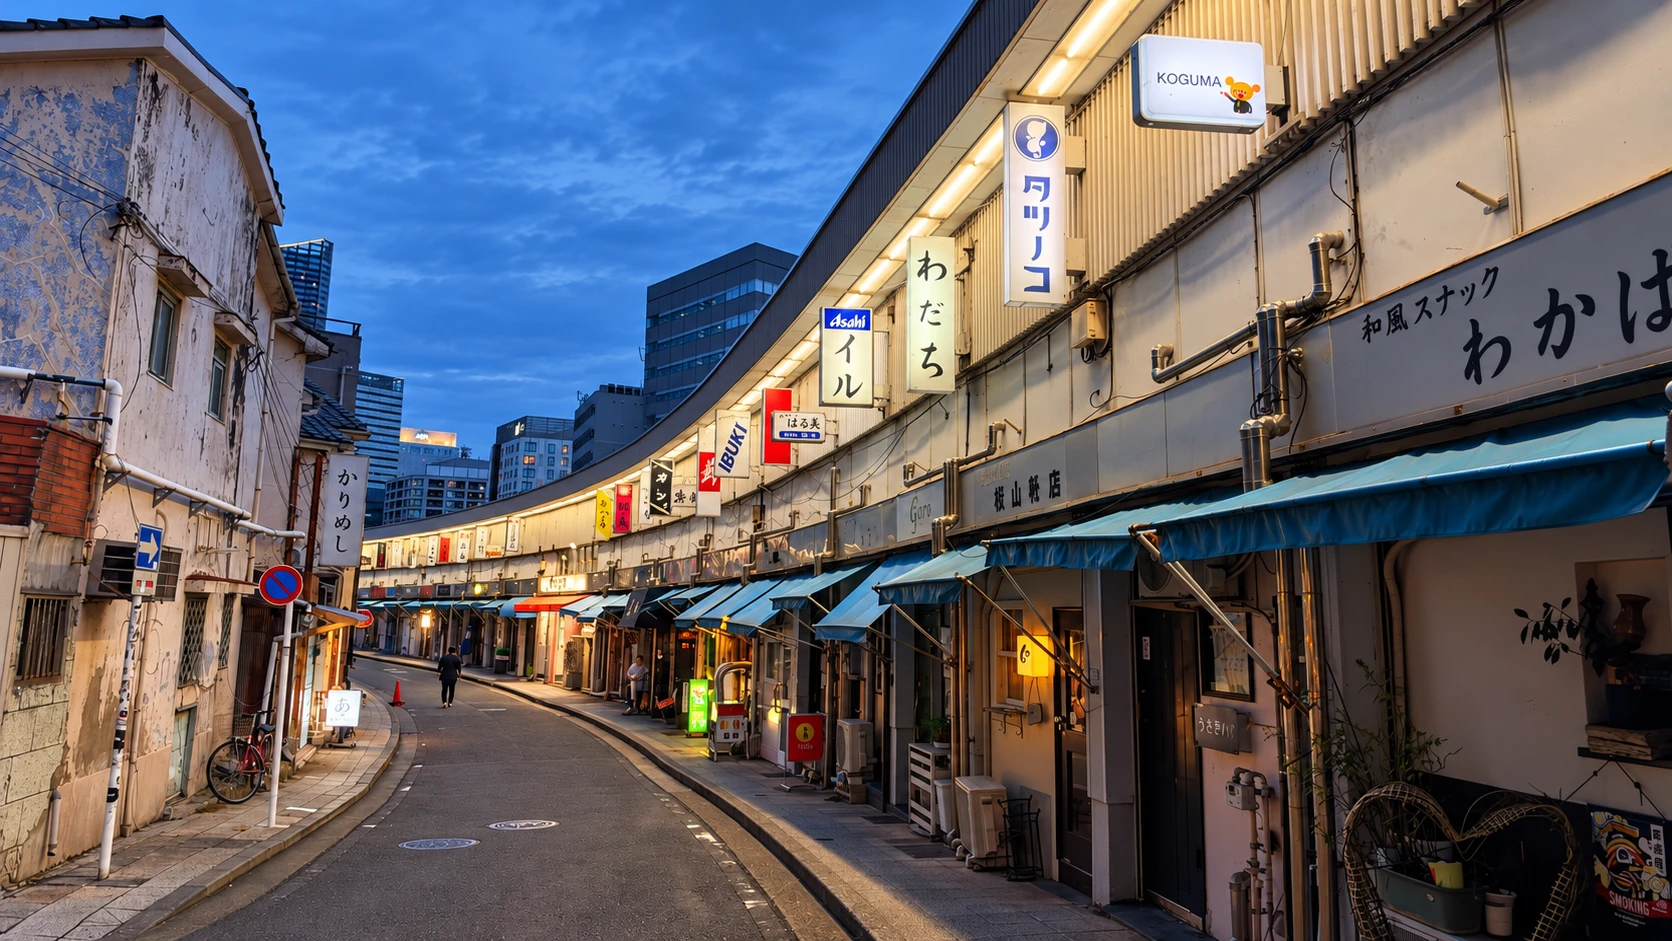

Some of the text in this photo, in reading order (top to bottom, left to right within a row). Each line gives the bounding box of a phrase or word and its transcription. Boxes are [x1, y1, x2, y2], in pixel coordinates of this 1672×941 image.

[1157, 72, 1222, 87] KOGUMA
[1023, 175, 1051, 293] タツノコ
[830, 313, 866, 328] Asahi
[917, 250, 947, 378] わだち
[1362, 266, 1499, 343] 和風スナック
[833, 334, 863, 399] イル
[718, 421, 748, 473] IBUKI
[334, 468, 358, 553] かりめし
[335, 697, 350, 713] あ
[1609, 890, 1650, 916] SMOKING
